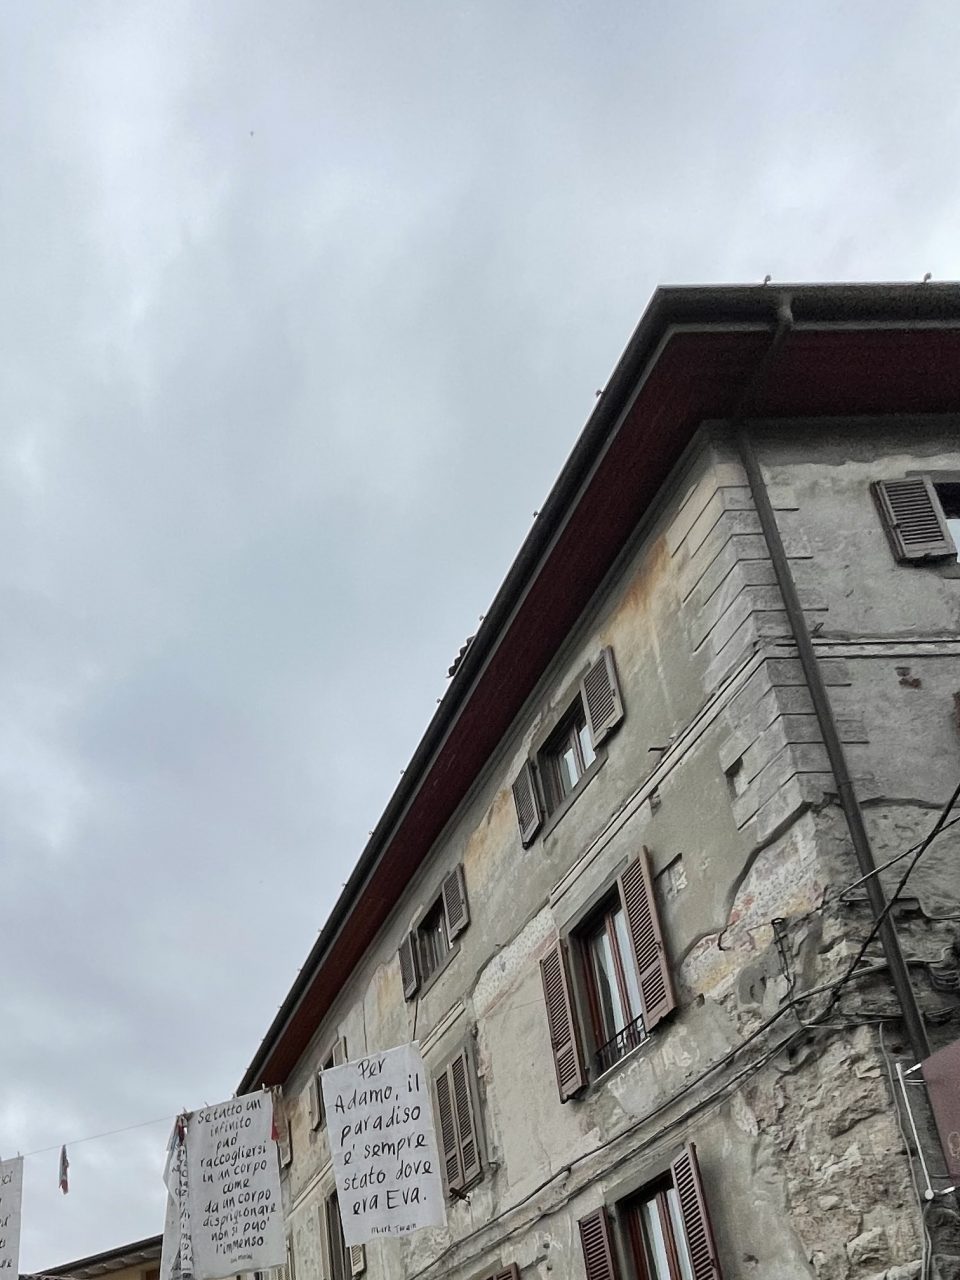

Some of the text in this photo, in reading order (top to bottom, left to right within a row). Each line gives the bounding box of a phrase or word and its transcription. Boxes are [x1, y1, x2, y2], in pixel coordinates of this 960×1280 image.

[357, 1057, 387, 1081] Per
[334, 1073, 420, 1115] Adamo, il
[210, 1117, 251, 1137] infinito
[340, 1105, 422, 1147] paradiso
[200, 1140, 267, 1169] raccogliersi
[364, 1132, 428, 1160] sempre
[202, 1170, 214, 1183] in
[234, 1159, 267, 1177] corpo
[343, 1159, 433, 1191] stato dove
[222, 1178, 250, 1195] come
[204, 1188, 271, 1214] da un corpo
[352, 1194, 378, 1215] era
[211, 1229, 229, 1242] non
